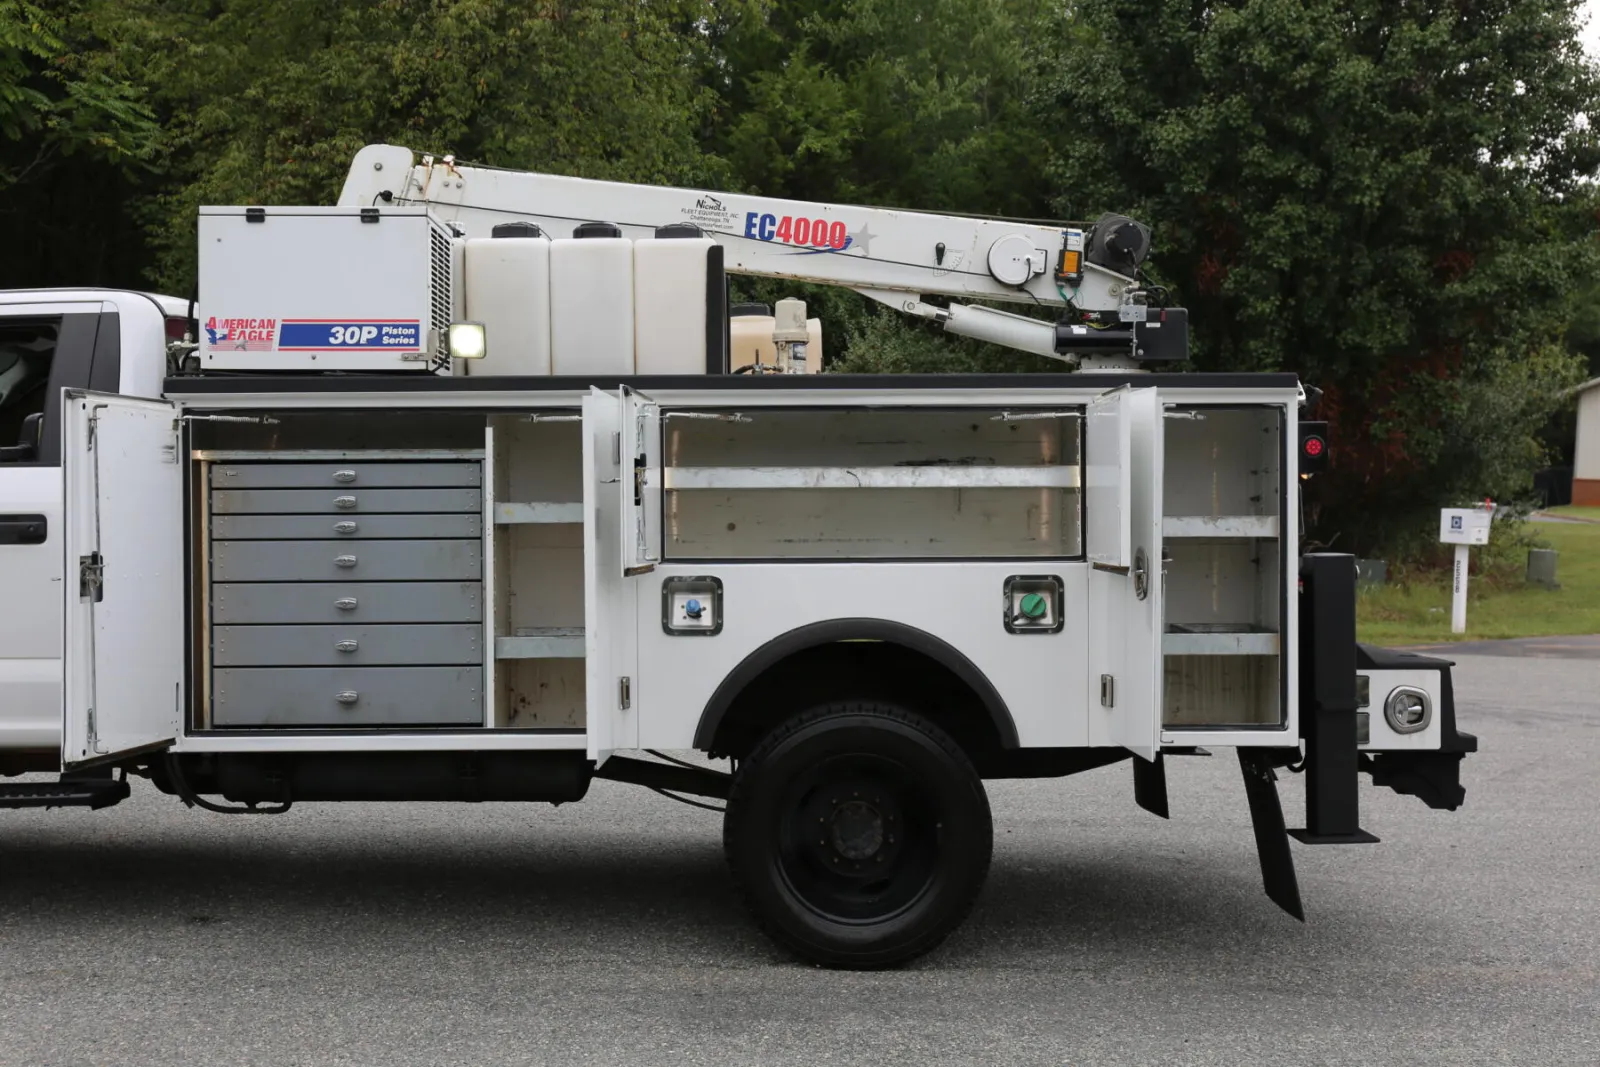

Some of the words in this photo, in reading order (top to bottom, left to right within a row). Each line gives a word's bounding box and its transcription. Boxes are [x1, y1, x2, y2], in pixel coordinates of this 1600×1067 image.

[745, 212, 847, 249] EC4000
[208, 317, 276, 329] AMERICAN
[228, 329, 275, 341] EAGLE
[329, 326, 378, 345] 30P
[382, 326, 415, 334] Piston
[382, 335, 415, 344] Series
